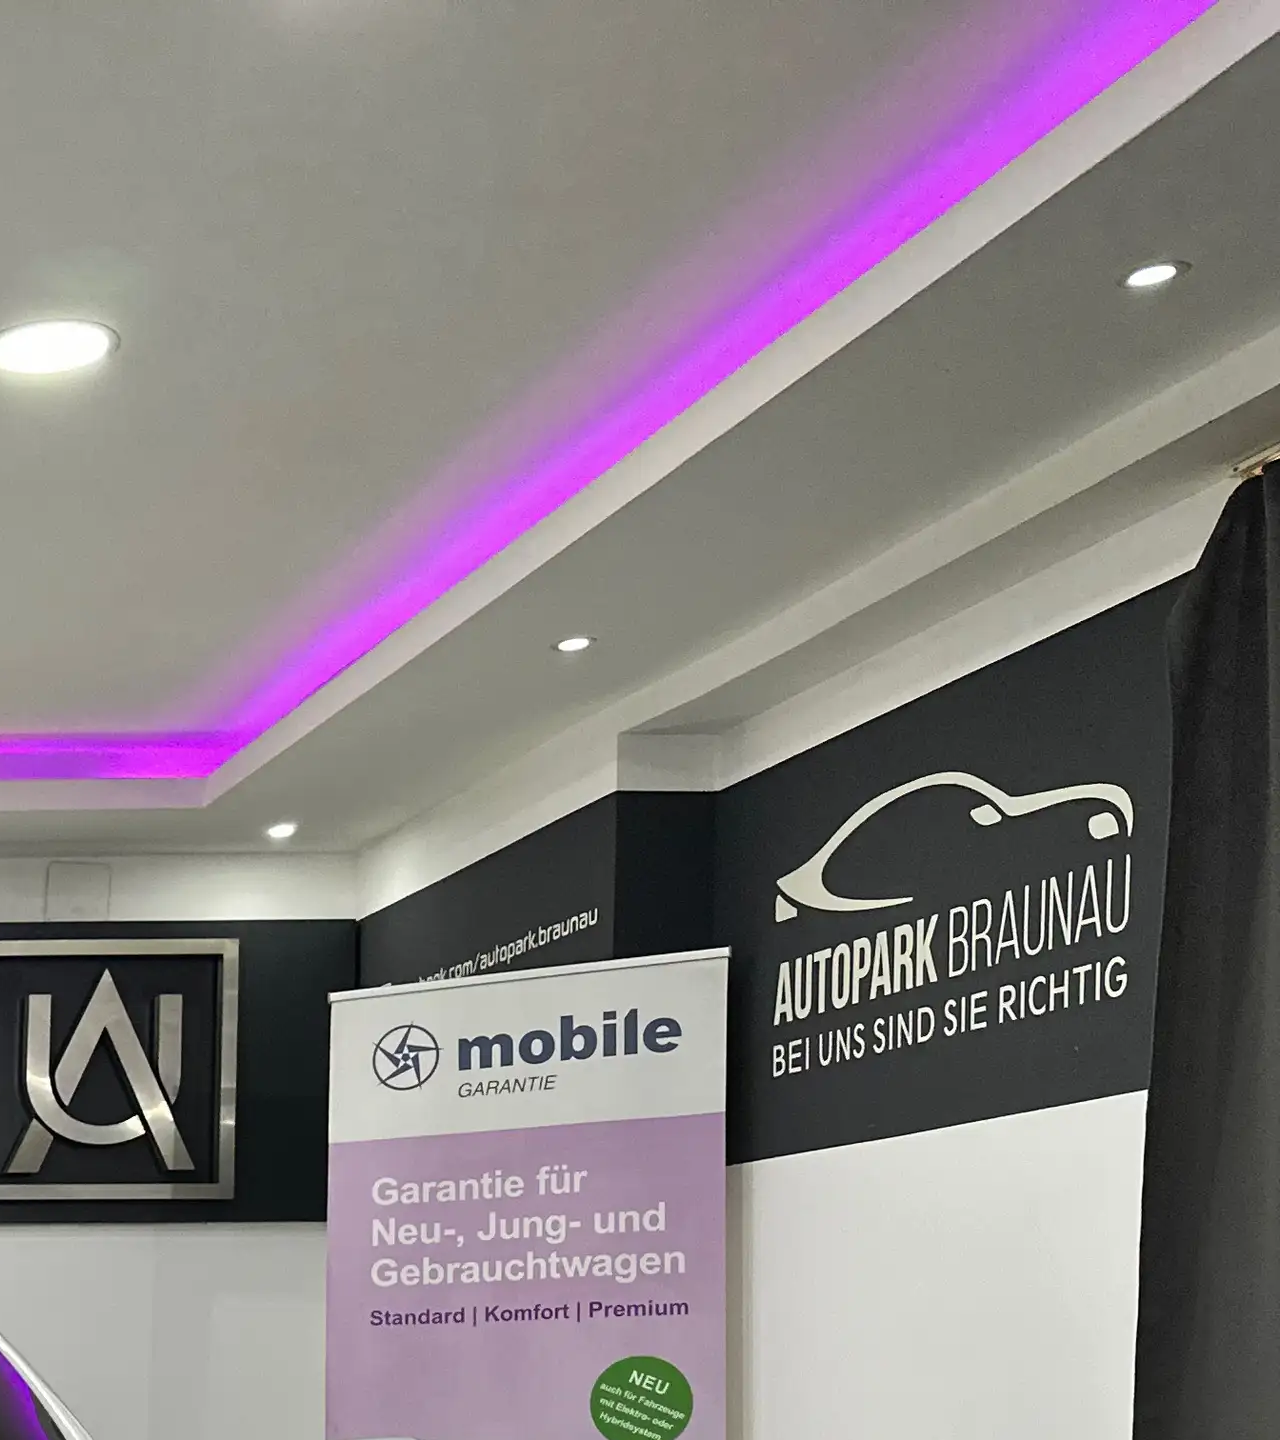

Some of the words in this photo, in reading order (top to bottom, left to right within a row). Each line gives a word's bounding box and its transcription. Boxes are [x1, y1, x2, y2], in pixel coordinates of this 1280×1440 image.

[772, 913, 939, 1026] AUTOPARK
[948, 853, 1131, 978] BRAUNAU
[772, 1037, 810, 1078] BEI
[818, 1023, 866, 1067] UNS
[872, 1006, 935, 1054] SIND
[943, 990, 988, 1037] SIE
[998, 955, 1128, 1024] RICHTIG
[458, 1008, 682, 1071] mobile
[457, 1074, 558, 1098] GARANTIE
[372, 1170, 525, 1206] Garantie
[536, 1164, 588, 1198] für
[372, 1217, 464, 1248] Neu-,
[477, 1212, 581, 1244] Jung-
[594, 1201, 665, 1234] und
[371, 1251, 685, 1287] Gebrauchtwagen
[370, 1307, 465, 1327] Standard
[484, 1303, 569, 1323] Komfort
[589, 1300, 689, 1319] Premium
[599, 1382, 623, 1396] auch
[623, 1390, 638, 1401] für
[637, 1395, 686, 1420] Fahrzeuge
[628, 1369, 671, 1395] NEU
[599, 1397, 615, 1409] mit
[652, 1417, 674, 1430] oder
